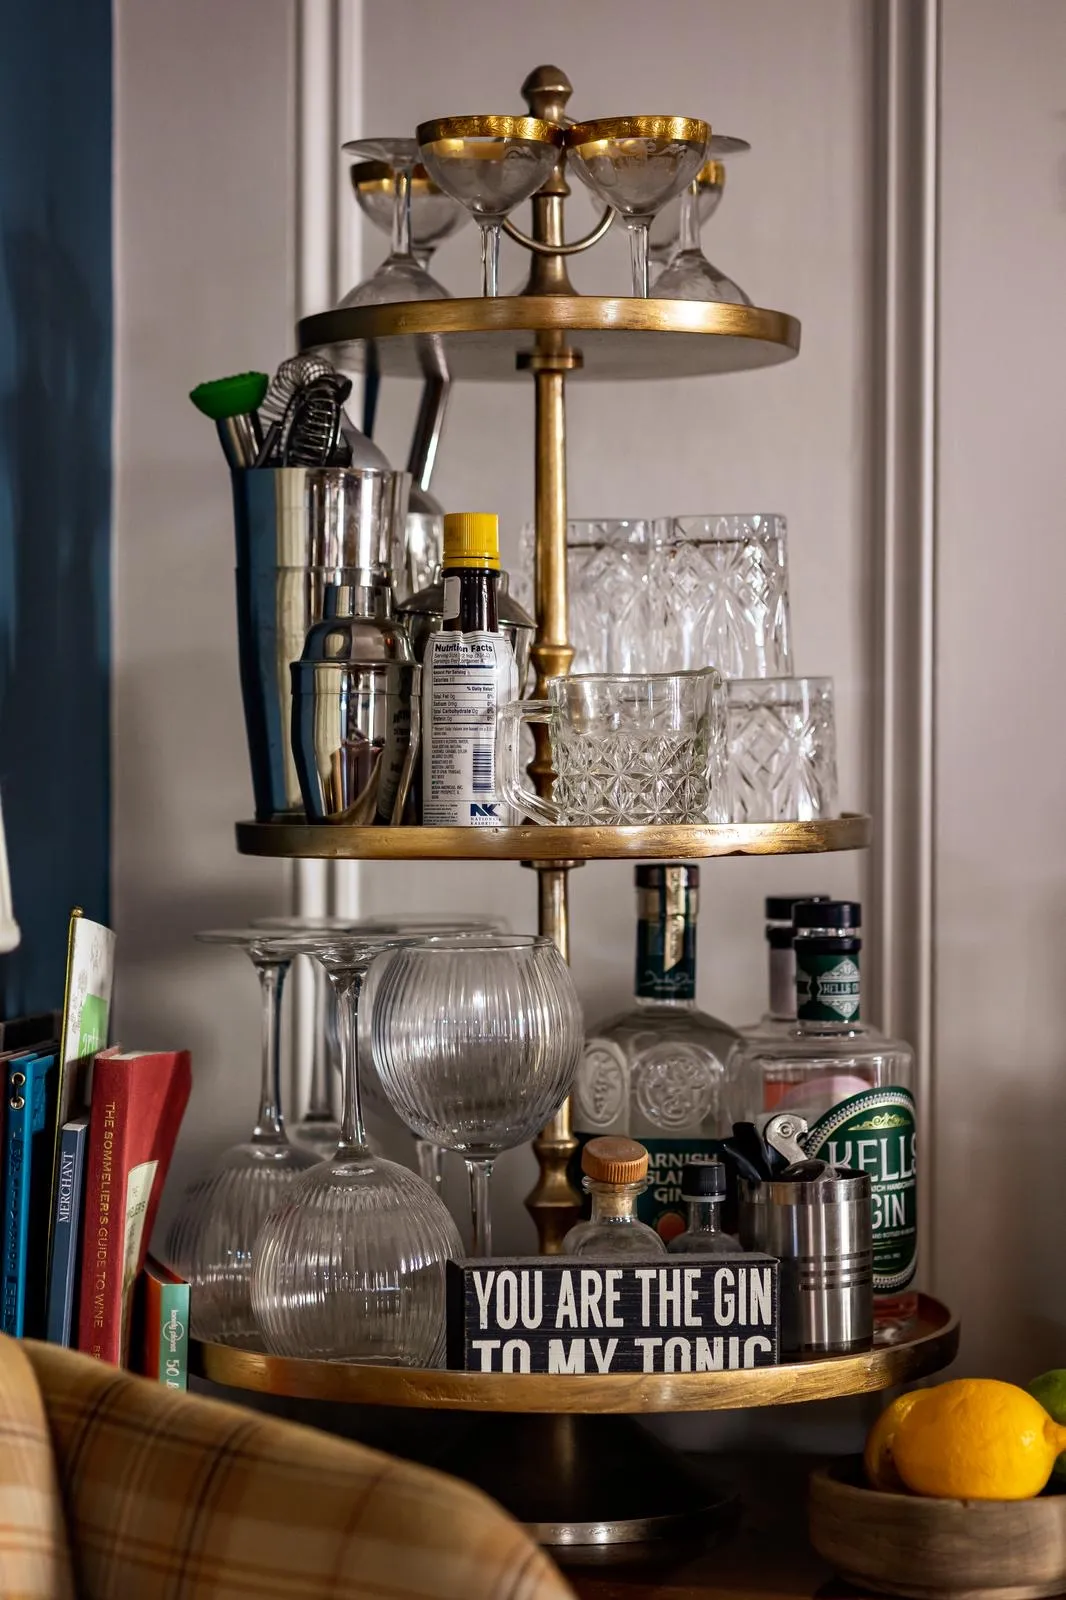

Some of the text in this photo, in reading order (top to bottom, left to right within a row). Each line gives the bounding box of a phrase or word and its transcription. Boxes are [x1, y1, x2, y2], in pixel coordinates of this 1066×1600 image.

[434, 643, 468, 652] Nutrition
[470, 804, 498, 816] NK
[104, 1102, 116, 1128] THE
[648, 1152, 718, 1167] ARNISH
[828, 1132, 917, 1182] KELLS
[58, 1152, 74, 1223] MERCHANT
[99, 1131, 114, 1224] SOMMELIER'S
[646, 1170, 682, 1185] SLA
[872, 1192, 905, 1230] GIN
[96, 1227, 108, 1267] GUIDE
[96, 1272, 106, 1290] TO
[93, 1294, 104, 1328] WINE
[473, 1268, 772, 1330] YOU ARE THE GIN
[168, 1309, 179, 1329] lonely
[169, 1331, 178, 1352] planet
[166, 1359, 179, 1376] 50
[472, 1336, 772, 1374] TO MY TONIC
